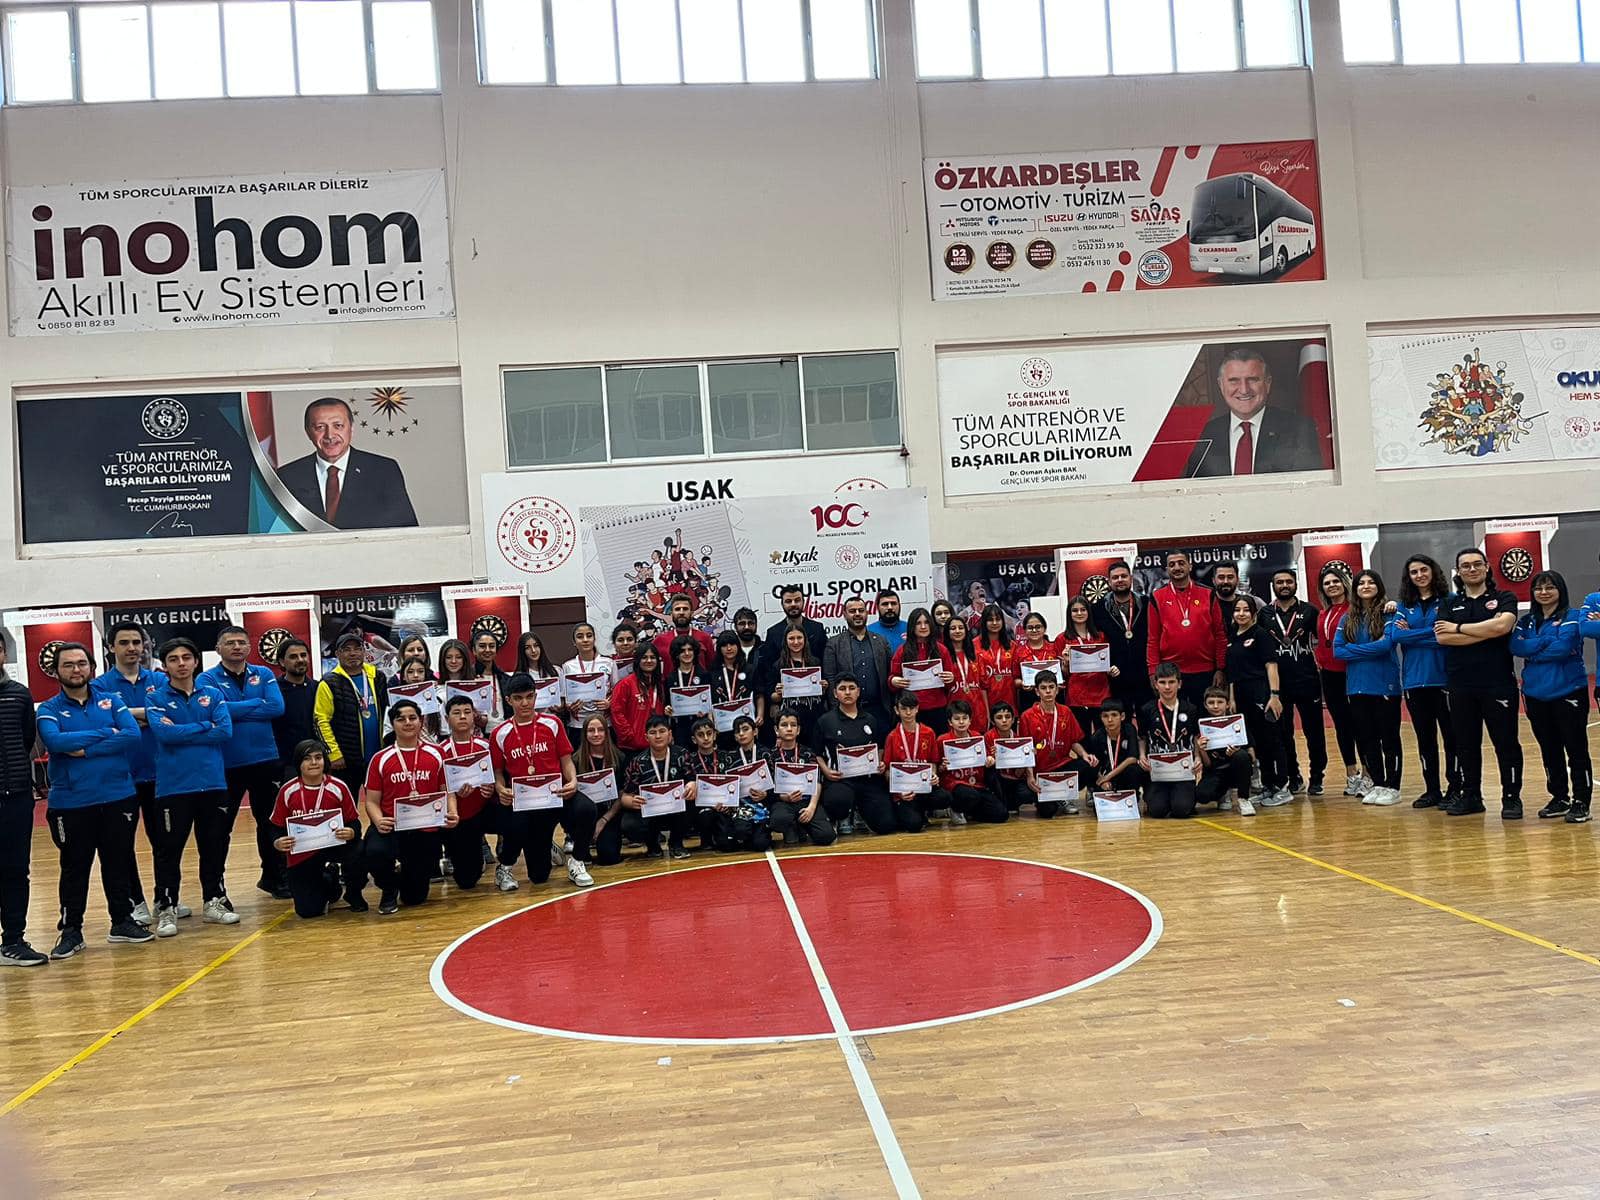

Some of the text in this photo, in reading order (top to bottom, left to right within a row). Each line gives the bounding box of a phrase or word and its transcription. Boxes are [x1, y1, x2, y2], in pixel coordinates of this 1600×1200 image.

[934, 160, 1141, 190] ÖZKARDEŞLER
[79, 178, 369, 201] TÜM SPORCULARIMIZA BAŞARILAR DİLERİZ
[960, 188, 1126, 212] OTOMOTİV TURİZM
[1044, 214, 1074, 222] ISUZU
[1088, 212, 1120, 220] HYUNDAI
[1130, 203, 1180, 224] SAVAŞ
[32, 195, 422, 281] inohom
[952, 248, 967, 257] D2
[38, 270, 424, 320] Akıllı Ev Sistemleri
[183, 311, 280, 322] www.inohom.com
[340, 304, 426, 314] info@inohom.com
[48, 322, 72, 330] 0850
[74, 320, 87, 328] 811
[104, 319, 116, 327] 83
[1557, 370, 1600, 388] OKU
[1022, 390, 1057, 400] GENÇLİK
[1058, 389, 1070, 397] VE
[1570, 392, 1592, 400] HEM
[1029, 397, 1070, 408] BAKANLIĞI
[952, 407, 1126, 432] TÜM ANTRENÖR VE
[960, 426, 1122, 450] SPORCULARIMIZA
[116, 448, 218, 463] TÜM ANTRENÖR
[951, 445, 1132, 470] BAŞARILAR DİLİYORUM
[101, 460, 233, 475] VE SPORCULARIMIZA
[105, 473, 232, 488] BAŞARILAR DİLİYORUM
[1000, 476, 1030, 486] GENÇLİK
[1060, 473, 1087, 481] BAKANI
[667, 478, 734, 502] USAK
[127, 496, 150, 504] Recep
[175, 493, 212, 502] ERDOĞAN
[144, 502, 210, 512] CUMHURBAŞKANI
[782, 546, 818, 566] Uşak
[864, 552, 890, 560] GENÇLİK
[1135, 555, 1162, 568] POR
[1189, 546, 1268, 563] ÜDÜRLÜĞÜ
[876, 558, 914, 567] MÜDÜRLÜĞÜ
[998, 562, 1036, 577] UŞAK
[772, 576, 918, 600] OUL SPORLARI
[322, 595, 418, 614] MÜDÜRLÜĞÜ
[158, 606, 228, 624] GENÇLİK
[390, 772, 406, 784] OTO
